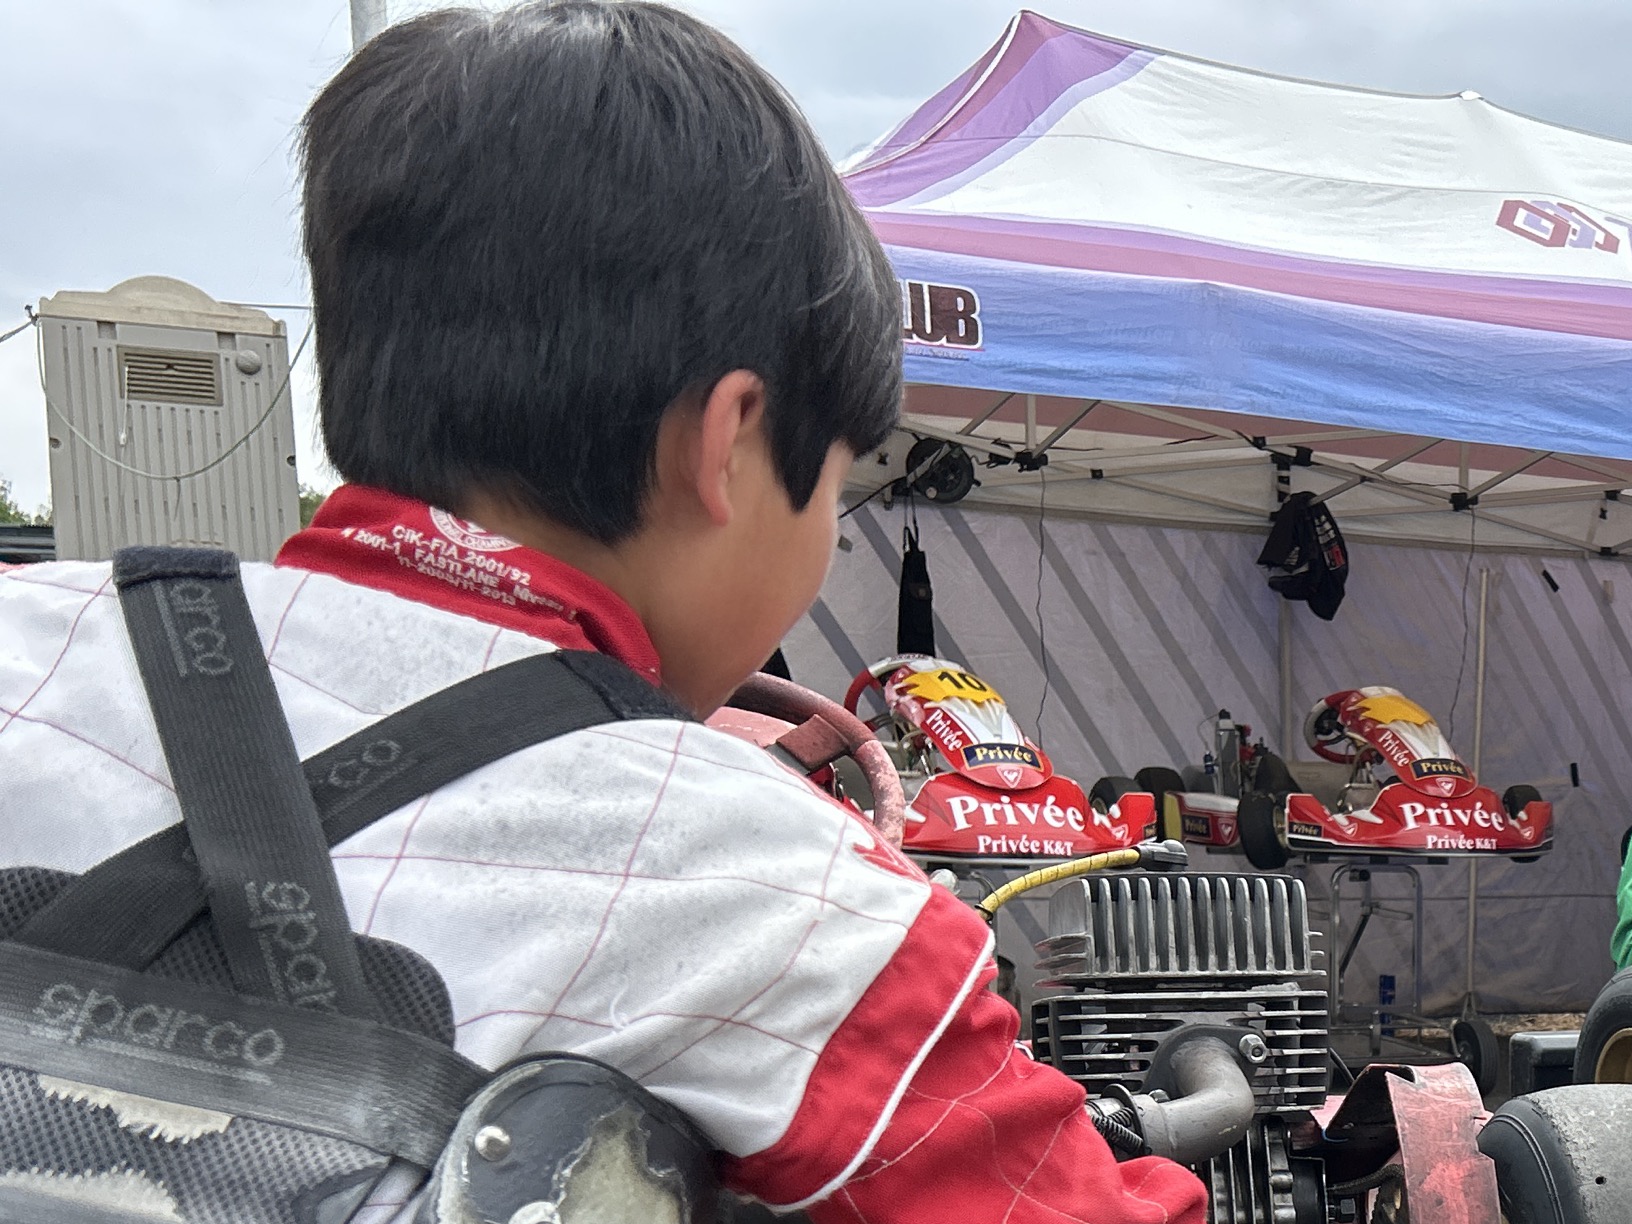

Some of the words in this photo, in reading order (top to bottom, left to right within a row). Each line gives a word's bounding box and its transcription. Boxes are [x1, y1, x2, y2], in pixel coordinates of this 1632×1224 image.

[925, 709, 964, 752] Privée
[975, 746, 1034, 763] Privée
[1421, 760, 1463, 775] Privée
[946, 795, 1086, 832] Privée
[1399, 801, 1505, 832] Privée
[978, 834, 1040, 855] Privée
[1043, 839, 1074, 855] K&T
[1426, 834, 1474, 850] Privée
[1475, 838, 1498, 850] K&T
[33, 983, 286, 1067] sparco
